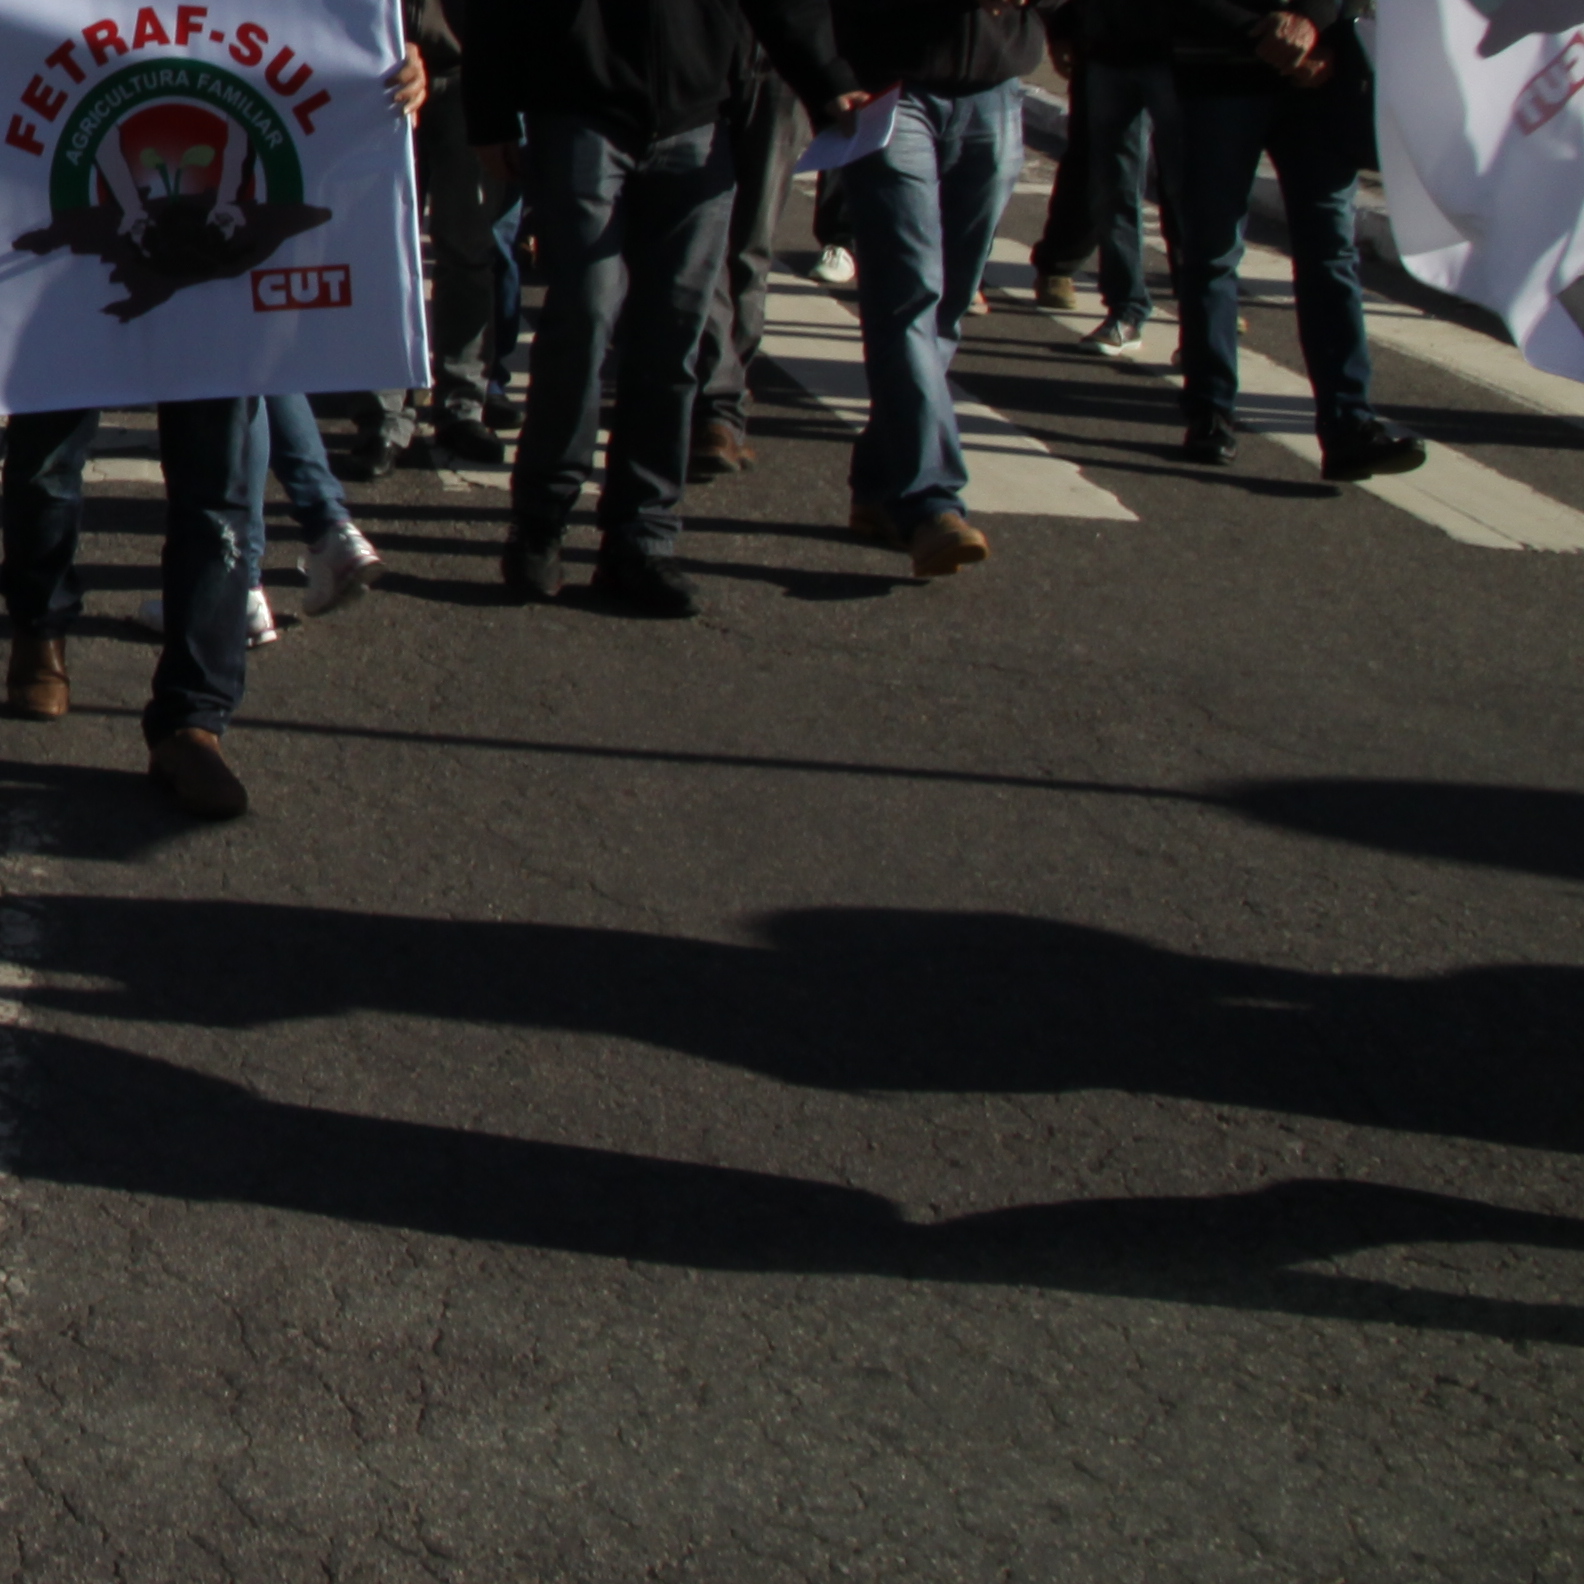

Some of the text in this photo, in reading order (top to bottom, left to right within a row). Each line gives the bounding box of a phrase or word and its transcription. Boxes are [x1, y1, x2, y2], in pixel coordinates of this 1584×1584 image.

[5, 4, 332, 157] FETRAF-SUL
[65, 68, 285, 167] AGRICULTURA FAMILIAR
[256, 268, 346, 307] CUT
